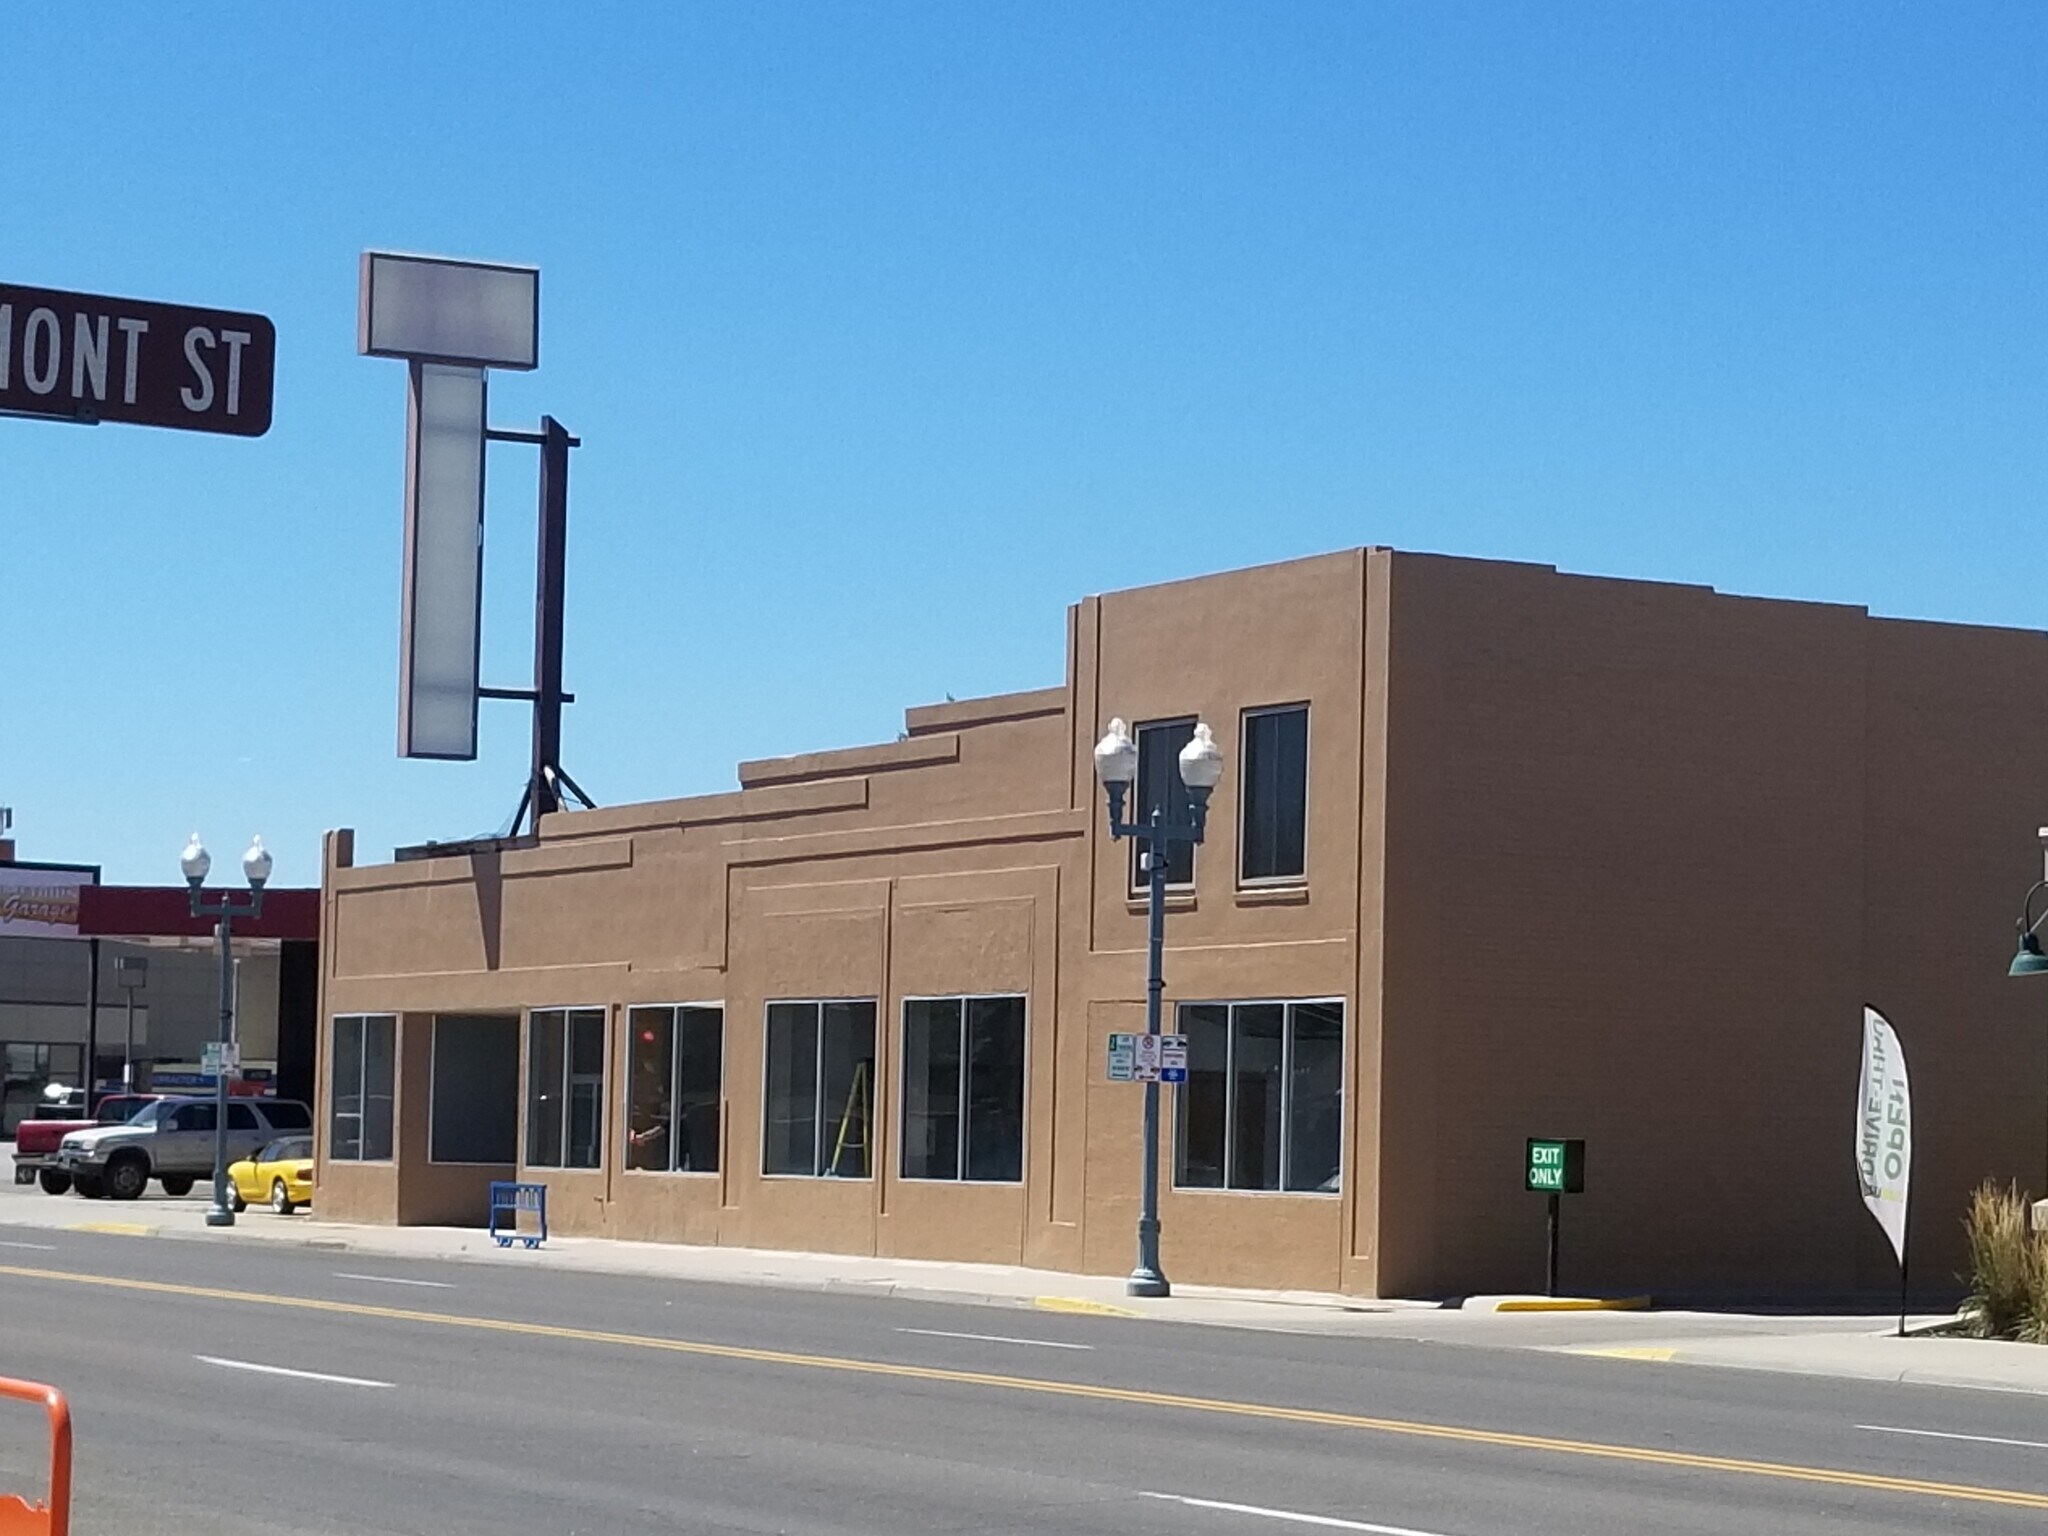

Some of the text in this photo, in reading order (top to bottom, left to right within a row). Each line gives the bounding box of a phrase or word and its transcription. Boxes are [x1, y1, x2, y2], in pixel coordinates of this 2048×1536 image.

[180, 326, 251, 415] ST
[1532, 1147, 1560, 1165] EXIT
[1529, 1167, 1563, 1185] ONLY
